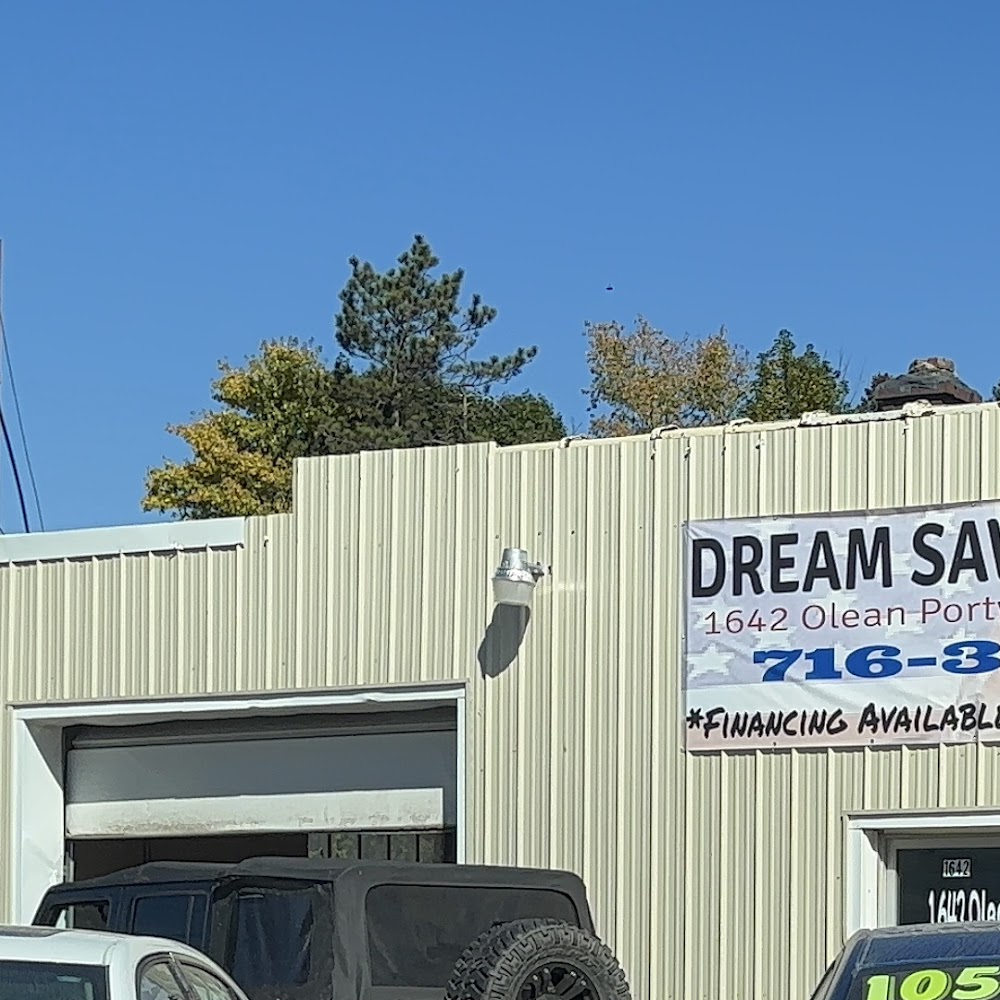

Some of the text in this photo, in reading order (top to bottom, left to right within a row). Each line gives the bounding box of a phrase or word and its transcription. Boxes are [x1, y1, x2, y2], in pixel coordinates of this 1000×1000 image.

[691, 526, 893, 598] DREAM
[705, 609, 788, 634] 1642
[802, 602, 906, 631] Olean
[943, 860, 971, 877] 1642
[928, 889, 965, 923] 1642
